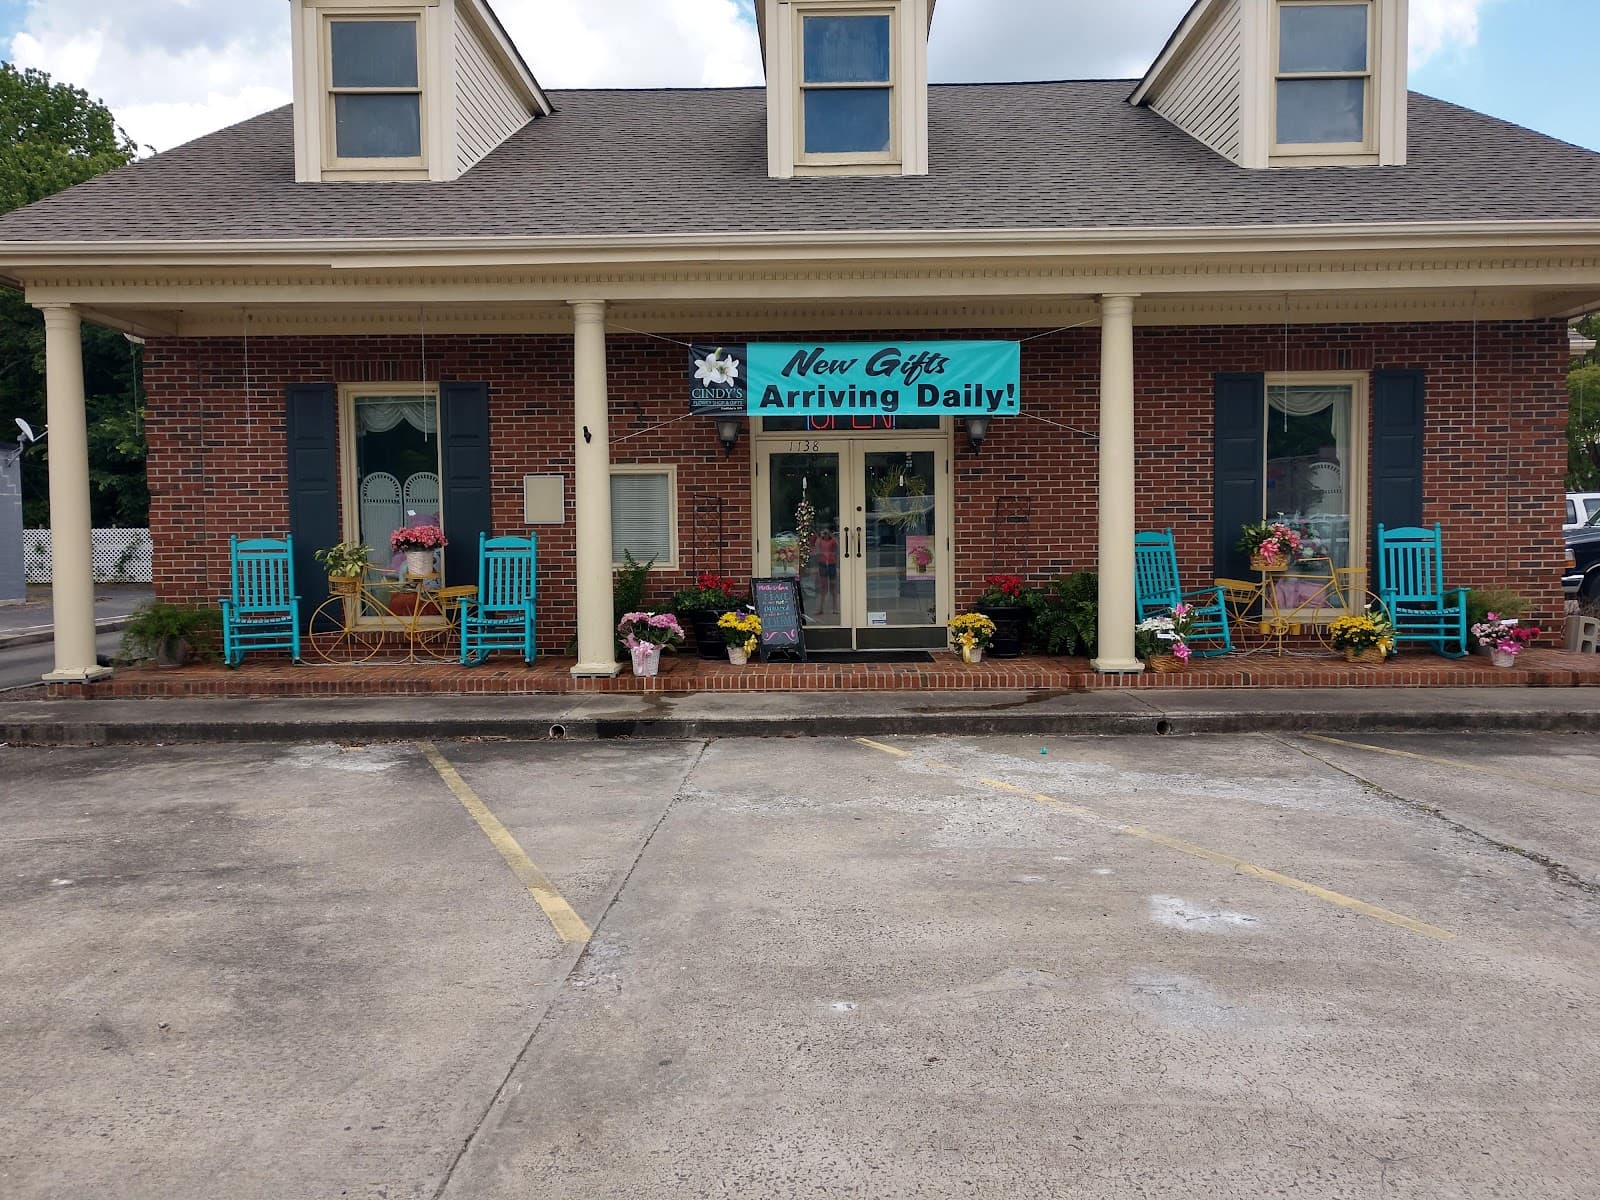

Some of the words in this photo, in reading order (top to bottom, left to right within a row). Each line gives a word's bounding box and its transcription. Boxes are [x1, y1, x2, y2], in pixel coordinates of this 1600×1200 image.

[781, 347, 858, 377] New
[865, 348, 951, 386] Gifts
[692, 388, 743, 398] CINDY'S
[759, 385, 899, 412] Arriving
[917, 383, 1015, 412] Daily!
[789, 441, 820, 452] 1138
